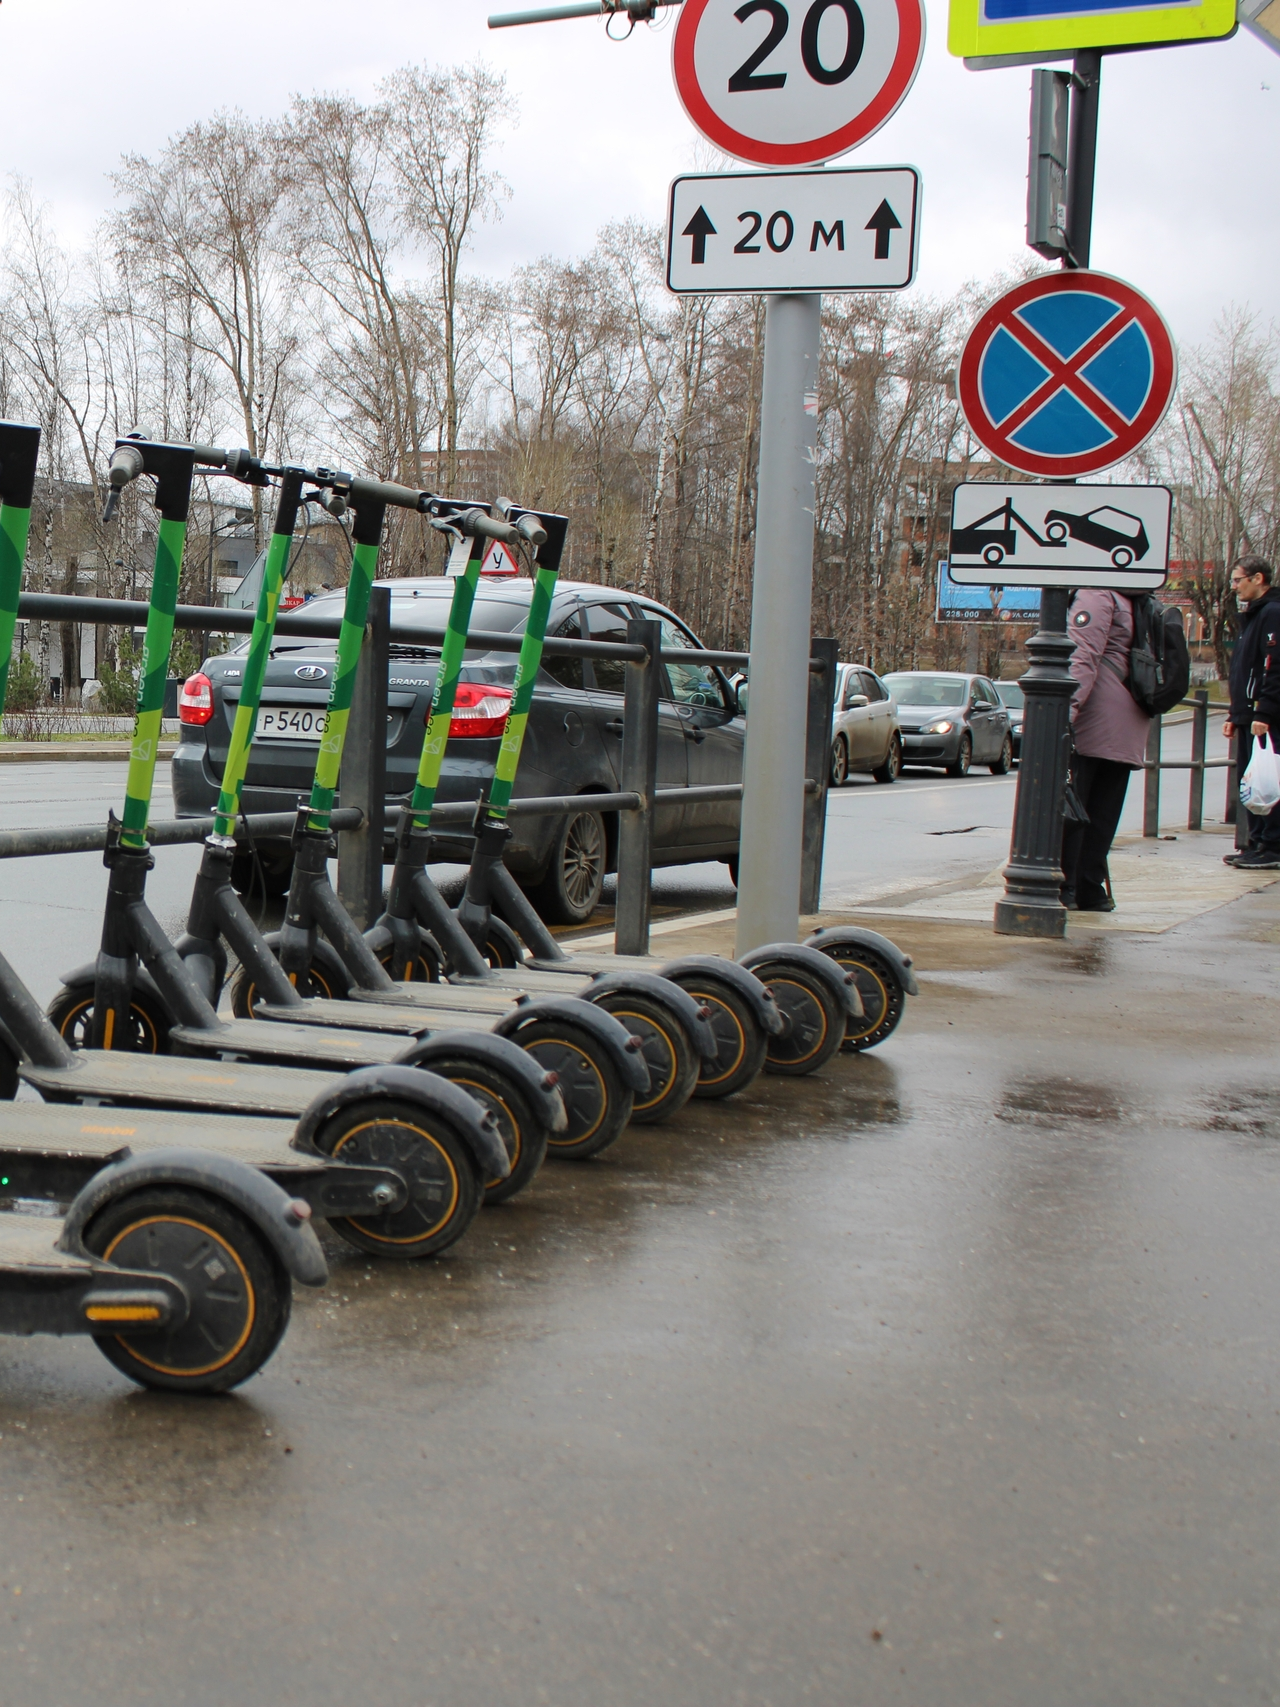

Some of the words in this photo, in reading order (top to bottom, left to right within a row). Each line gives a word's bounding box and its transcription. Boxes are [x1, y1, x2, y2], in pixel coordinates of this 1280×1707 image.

[728, 0, 865, 93] 20
[733, 210, 794, 254] 20
[223, 669, 240, 677] LADA
[389, 677, 430, 687] GRANTA
